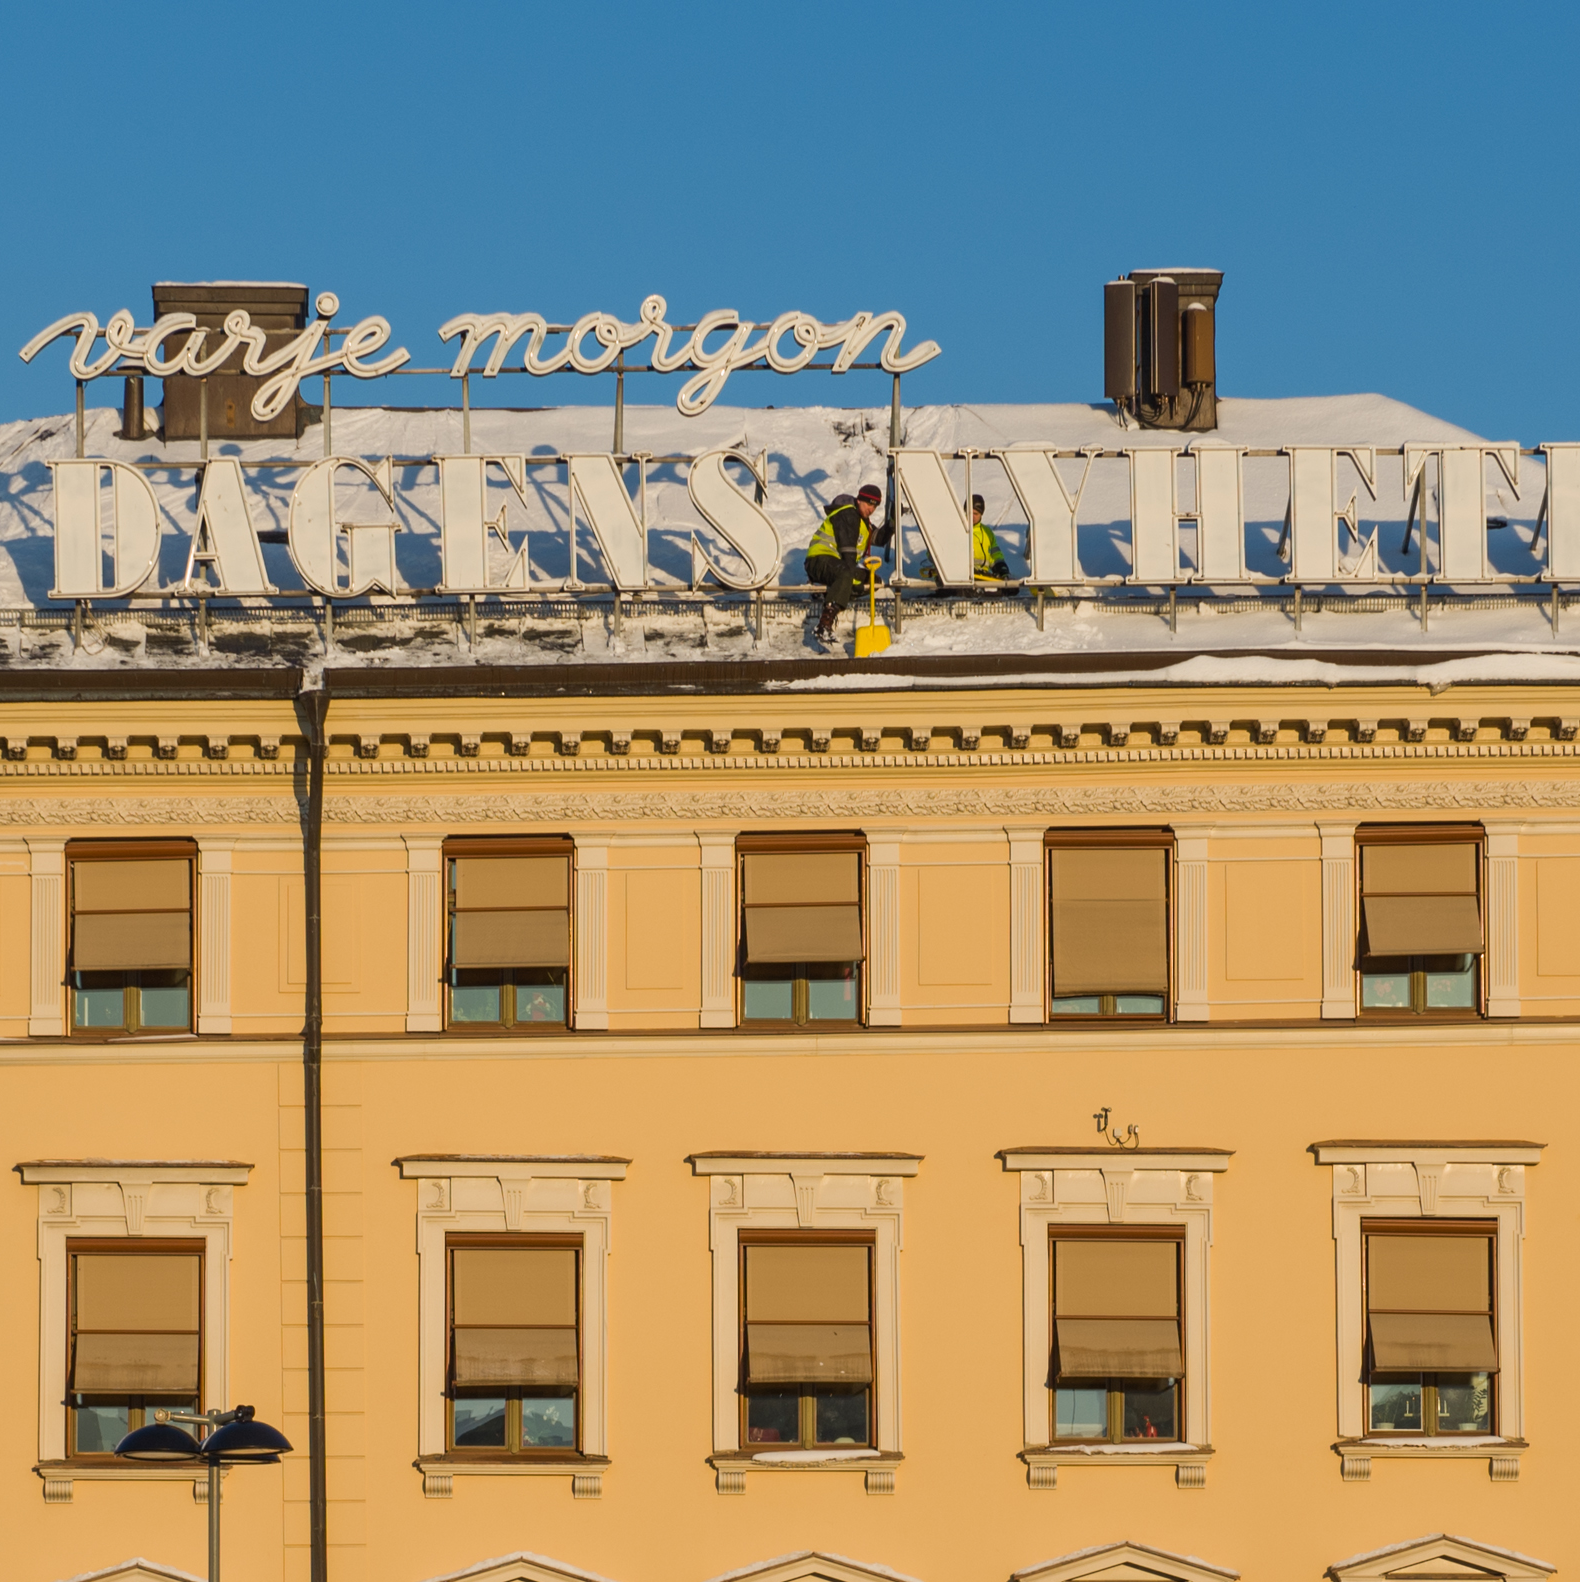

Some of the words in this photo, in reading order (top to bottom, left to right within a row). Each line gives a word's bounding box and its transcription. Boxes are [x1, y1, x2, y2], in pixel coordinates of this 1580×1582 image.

[20, 292, 411, 422] varje
[438, 294, 942, 416] morgon
[45, 447, 782, 599] DAGENS
